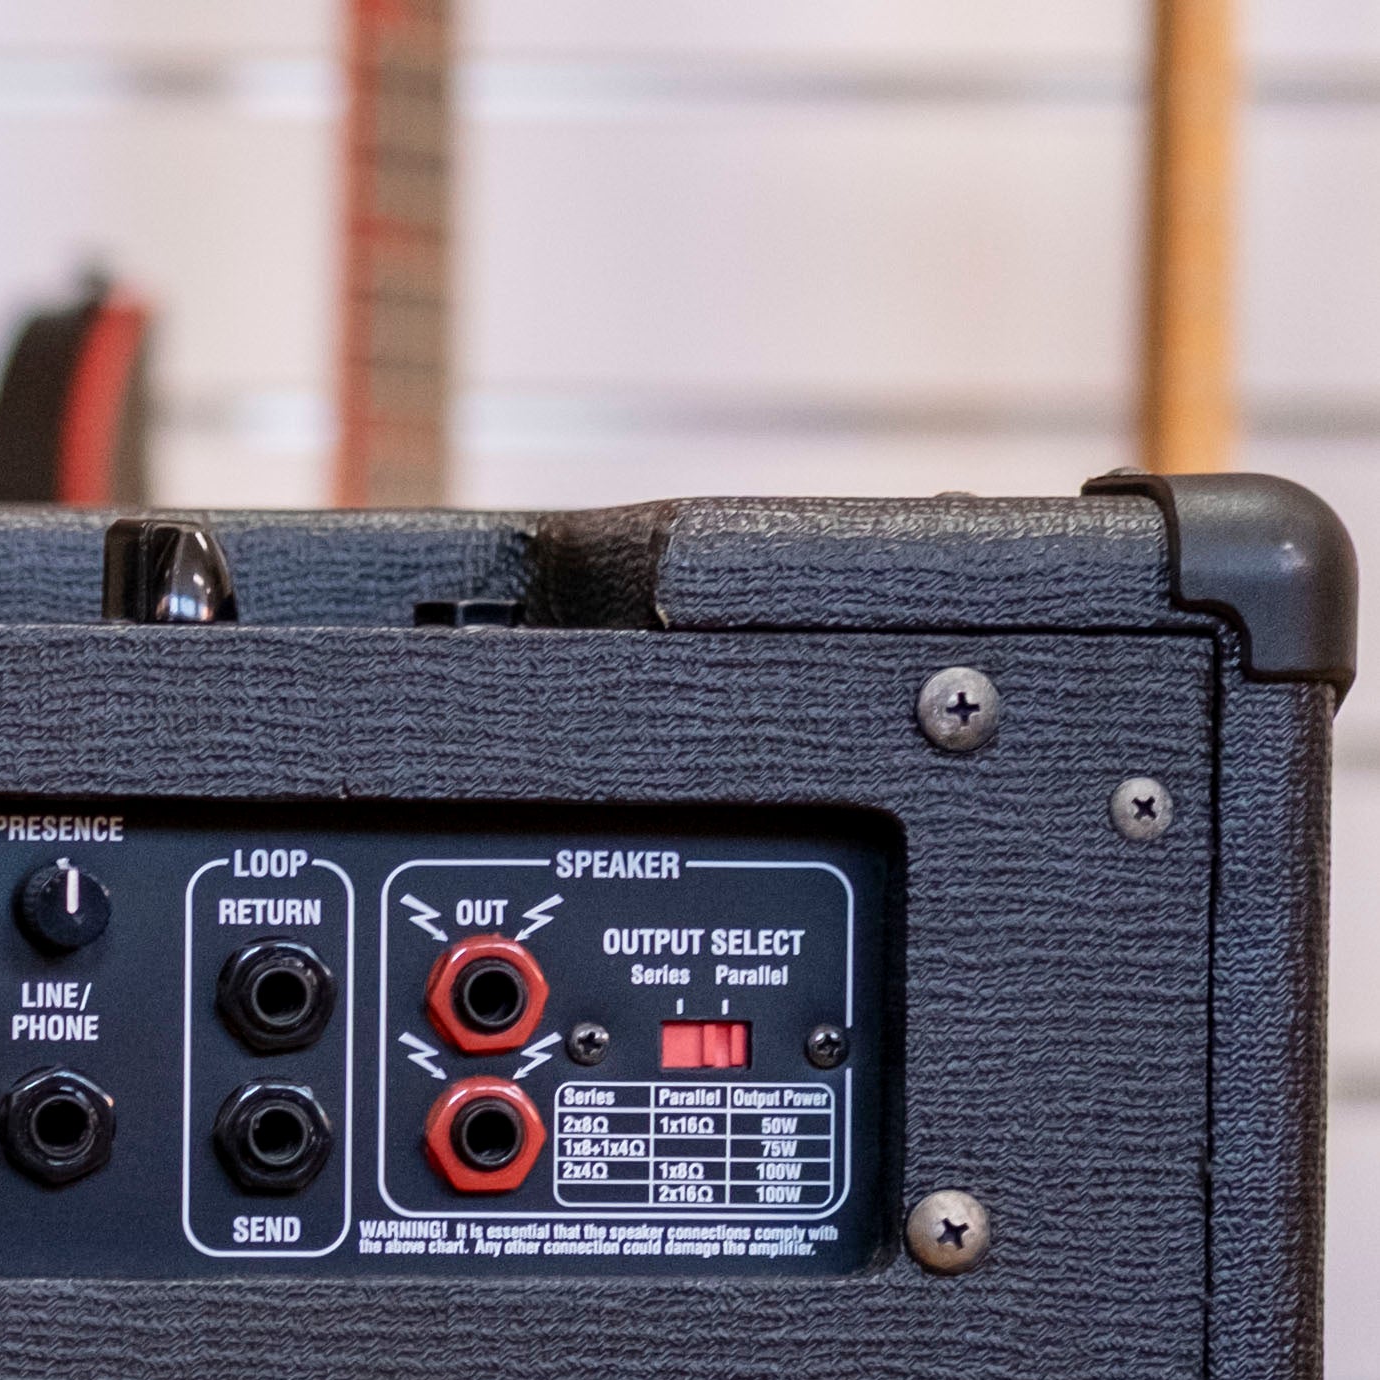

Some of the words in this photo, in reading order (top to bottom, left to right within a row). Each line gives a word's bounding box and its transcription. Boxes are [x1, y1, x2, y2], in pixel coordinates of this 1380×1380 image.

[233, 848, 309, 879] LOOP
[555, 849, 681, 880] SPEAKER
[218, 898, 323, 927] RETURN
[456, 899, 509, 926] OUT
[602, 927, 706, 957] OUTPUT
[710, 927, 806, 957] SELECT
[630, 963, 691, 986] Series
[715, 963, 789, 986] Parallel
[20, 980, 93, 1012] LINE/
[10, 1014, 100, 1042] PHONE
[563, 1087, 616, 1106] Series
[658, 1087, 722, 1107] Parallel
[732, 1088, 781, 1109] Output
[783, 1088, 828, 1107] Power
[562, 1116, 609, 1134] 2x8Ω
[659, 1116, 715, 1134] 1x16Ω
[760, 1117, 798, 1135] 50W
[761, 1140, 798, 1157] 75W
[562, 1161, 609, 1180] 2x4Ω
[659, 1162, 705, 1180] 1x8Ω
[755, 1163, 802, 1181] 100W
[658, 1185, 714, 1203] 2x16Ω
[755, 1186, 802, 1204] 100W
[232, 1216, 301, 1244] SEND
